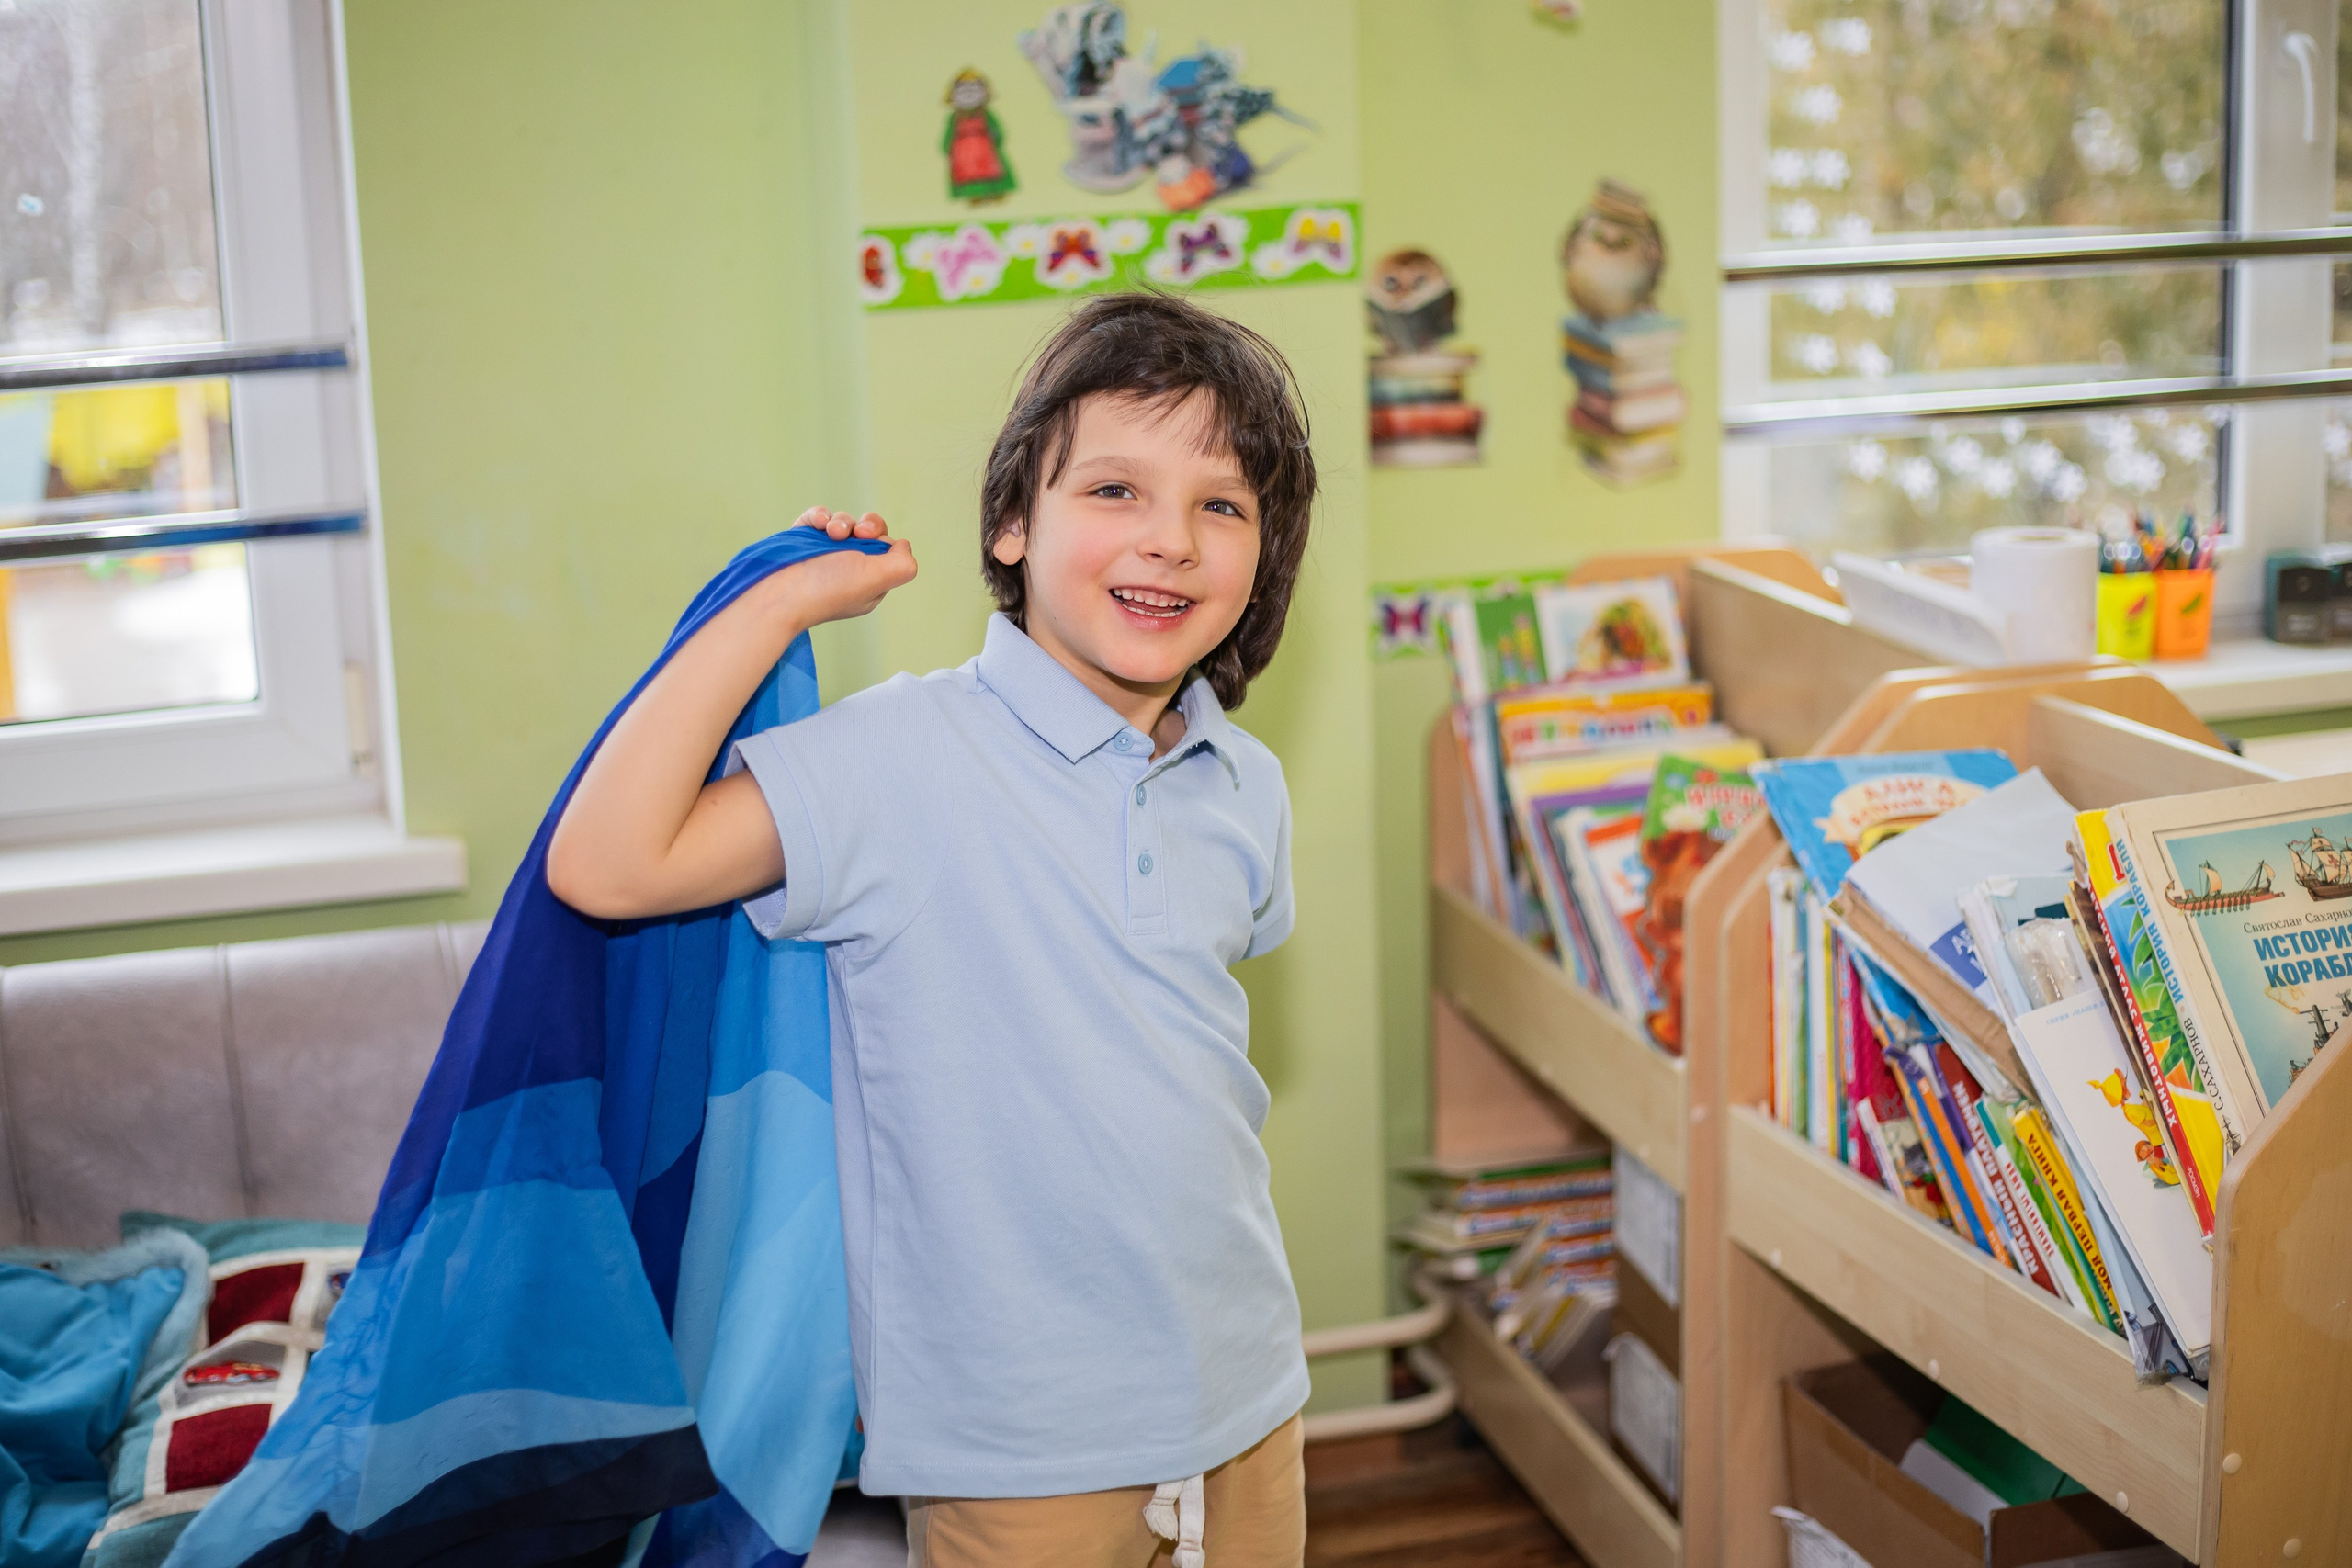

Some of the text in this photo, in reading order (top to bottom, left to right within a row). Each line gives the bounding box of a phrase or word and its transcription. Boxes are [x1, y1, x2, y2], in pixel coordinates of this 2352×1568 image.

[2116, 838, 2151, 919] КОРАБЛЯ
[2243, 908, 2352, 934] Святослав Сахарно
[2147, 921, 2185, 1004] ИСТОРИЯ
[2114, 964, 2138, 1021] АТЛАС
[2135, 1022, 2178, 1129] ЖИВОТНЫХ
[2184, 1018, 2223, 1111] С.САХАРНОВ
[1952, 1080, 1998, 1177] ПЛАТОЧЕК
[2028, 1133, 2059, 1187] КНИГА
[2056, 1189, 2094, 1252] ПЕРВАЯ
[2092, 1254, 2112, 1291] МОЯ
